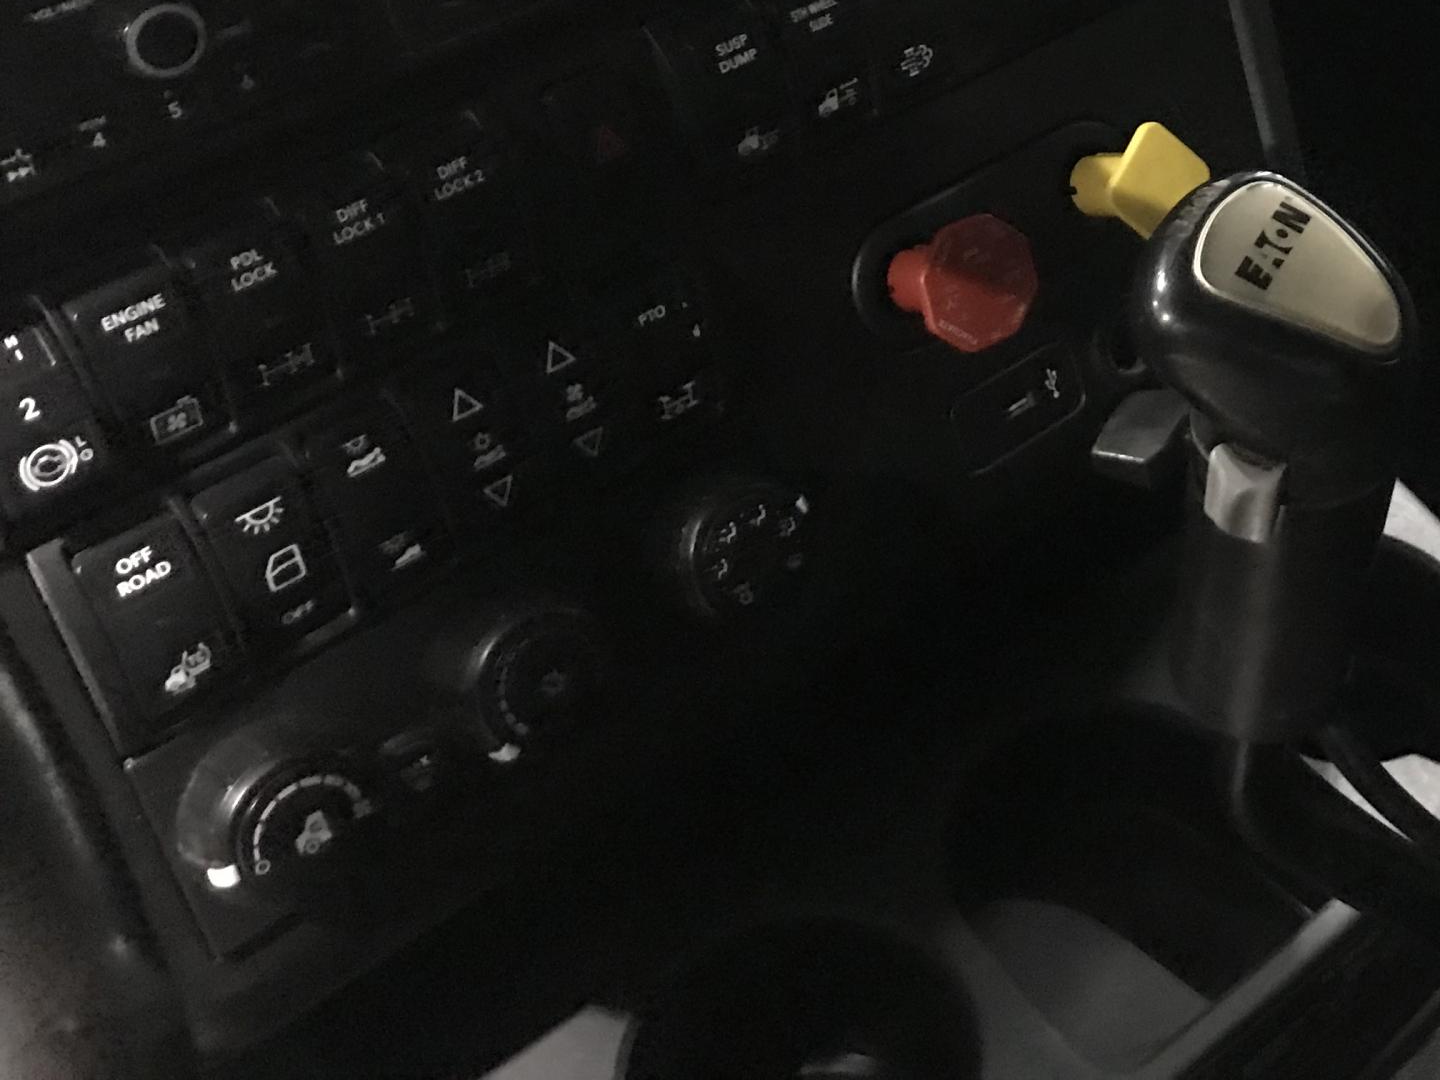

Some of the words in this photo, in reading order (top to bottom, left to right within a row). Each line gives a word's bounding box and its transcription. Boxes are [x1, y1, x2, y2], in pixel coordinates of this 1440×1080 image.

[714, 32, 749, 57] SUSP
[718, 47, 758, 74] DUMP
[436, 156, 468, 180] DIFF
[434, 170, 472, 201] LOCK
[472, 169, 487, 185] 2
[336, 199, 369, 223] DIFF
[333, 218, 373, 245] LOCK
[374, 212, 387, 226] 1
[230, 262, 279, 293] LOCK
[101, 293, 168, 333] ENGINE
[637, 304, 667, 327] PTO
[124, 318, 161, 344] FAN
[19, 397, 42, 421] 2
[115, 545, 154, 575] OFF
[116, 561, 172, 598] ROAD
